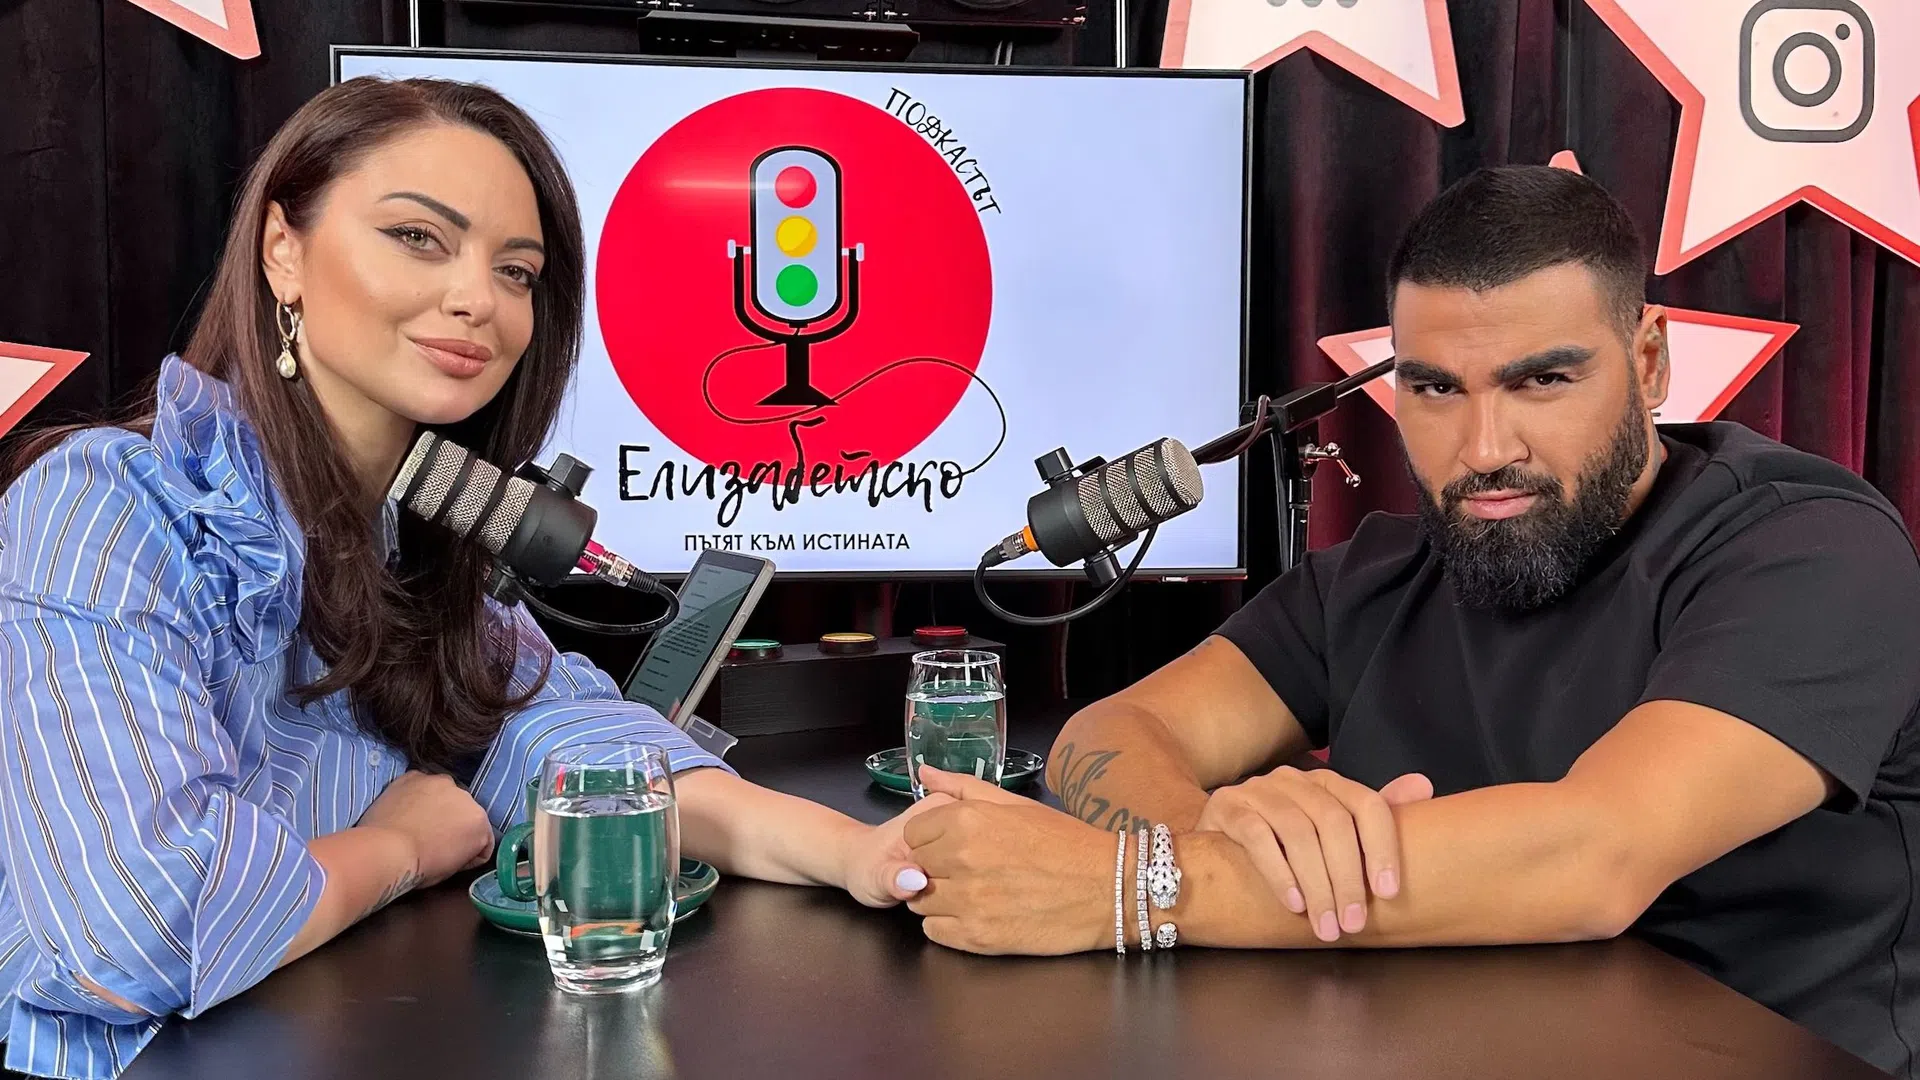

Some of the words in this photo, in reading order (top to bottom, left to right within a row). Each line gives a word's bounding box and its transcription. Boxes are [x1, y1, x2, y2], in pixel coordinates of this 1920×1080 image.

[885, 87, 1001, 214] ПОДКАСТЪТ
[618, 416, 964, 527] Елизабетско
[684, 534, 743, 551] ПЪТЯТ
[751, 534, 796, 551] КЪМ
[803, 533, 910, 550] ИСТИНАТА
